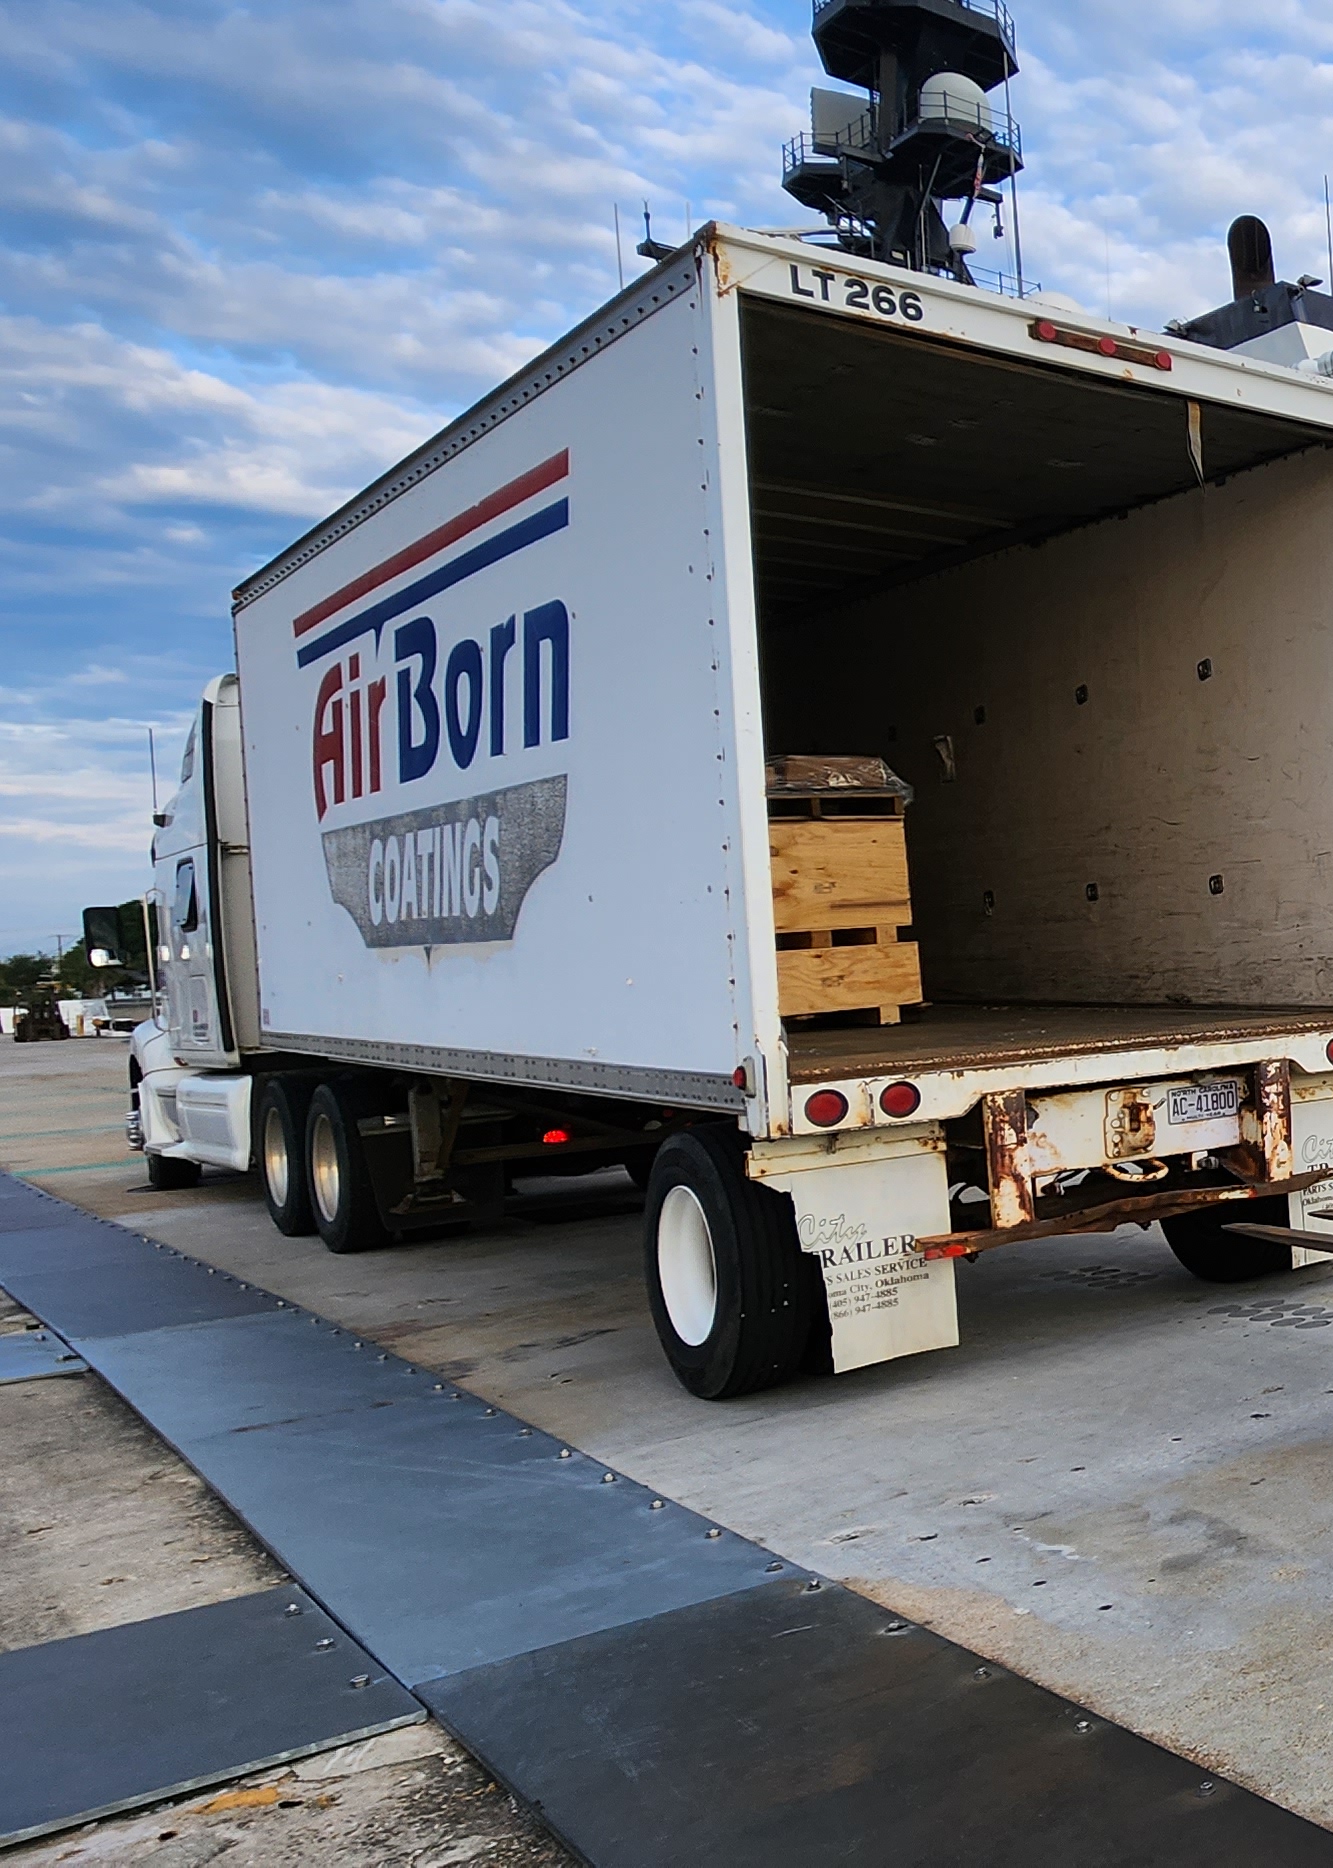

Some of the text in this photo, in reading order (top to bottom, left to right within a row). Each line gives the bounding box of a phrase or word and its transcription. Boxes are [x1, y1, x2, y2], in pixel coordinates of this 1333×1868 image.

[789, 264, 923, 321] LT 266
[313, 599, 569, 823] AirBorn
[368, 816, 500, 926] COATINGS
[1171, 1084, 1233, 1097] NORTH CAROLINA
[1172, 1091, 1235, 1117] AC-41800
[797, 1213, 867, 1255] City
[820, 1233, 917, 1269] RAILER
[836, 1268, 872, 1284] SALES
[874, 1257, 928, 1276] SERVICE
[875, 1272, 929, 1288] Oklahoma
[854, 1287, 899, 1303] 947-4885
[855, 1298, 899, 1314] 947-4885
